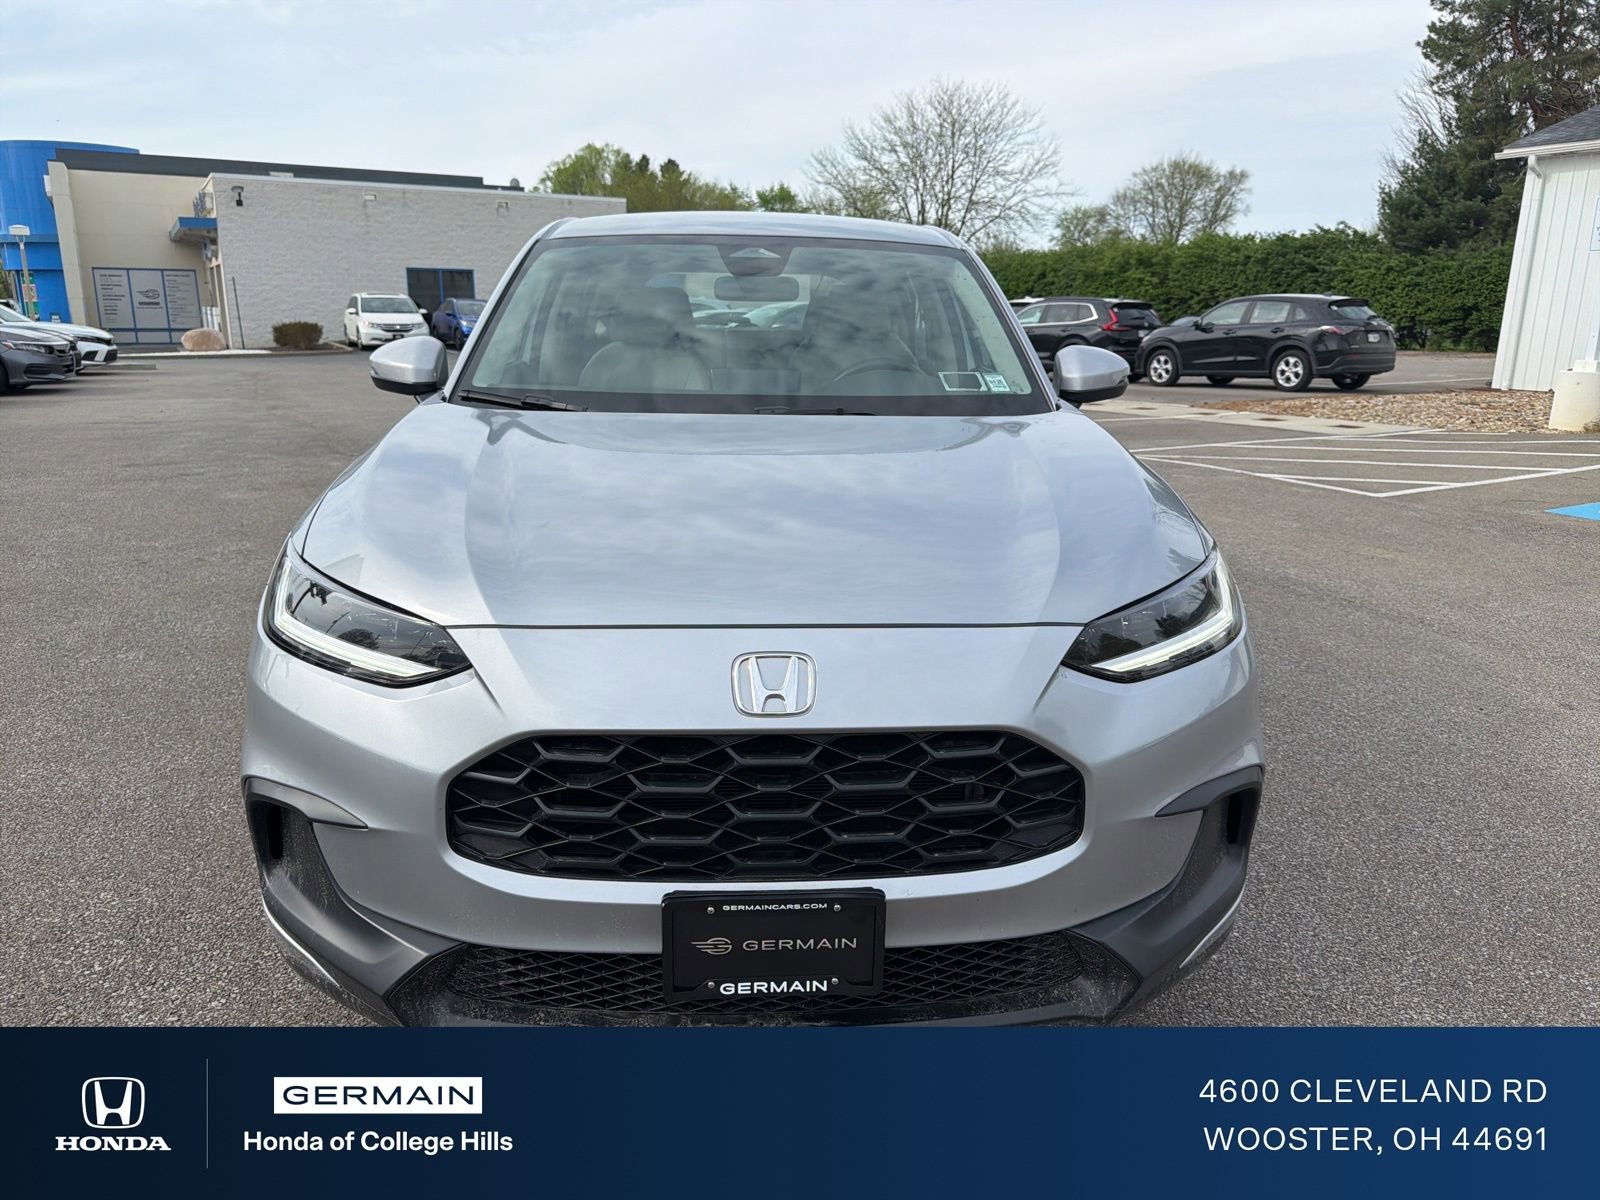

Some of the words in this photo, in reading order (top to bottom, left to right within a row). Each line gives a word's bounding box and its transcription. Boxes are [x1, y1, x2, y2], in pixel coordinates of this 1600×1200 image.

[722, 903, 828, 911] GERMAINCARS.COM
[742, 937, 857, 951] GERMAIN
[719, 979, 828, 996] GERMAIN
